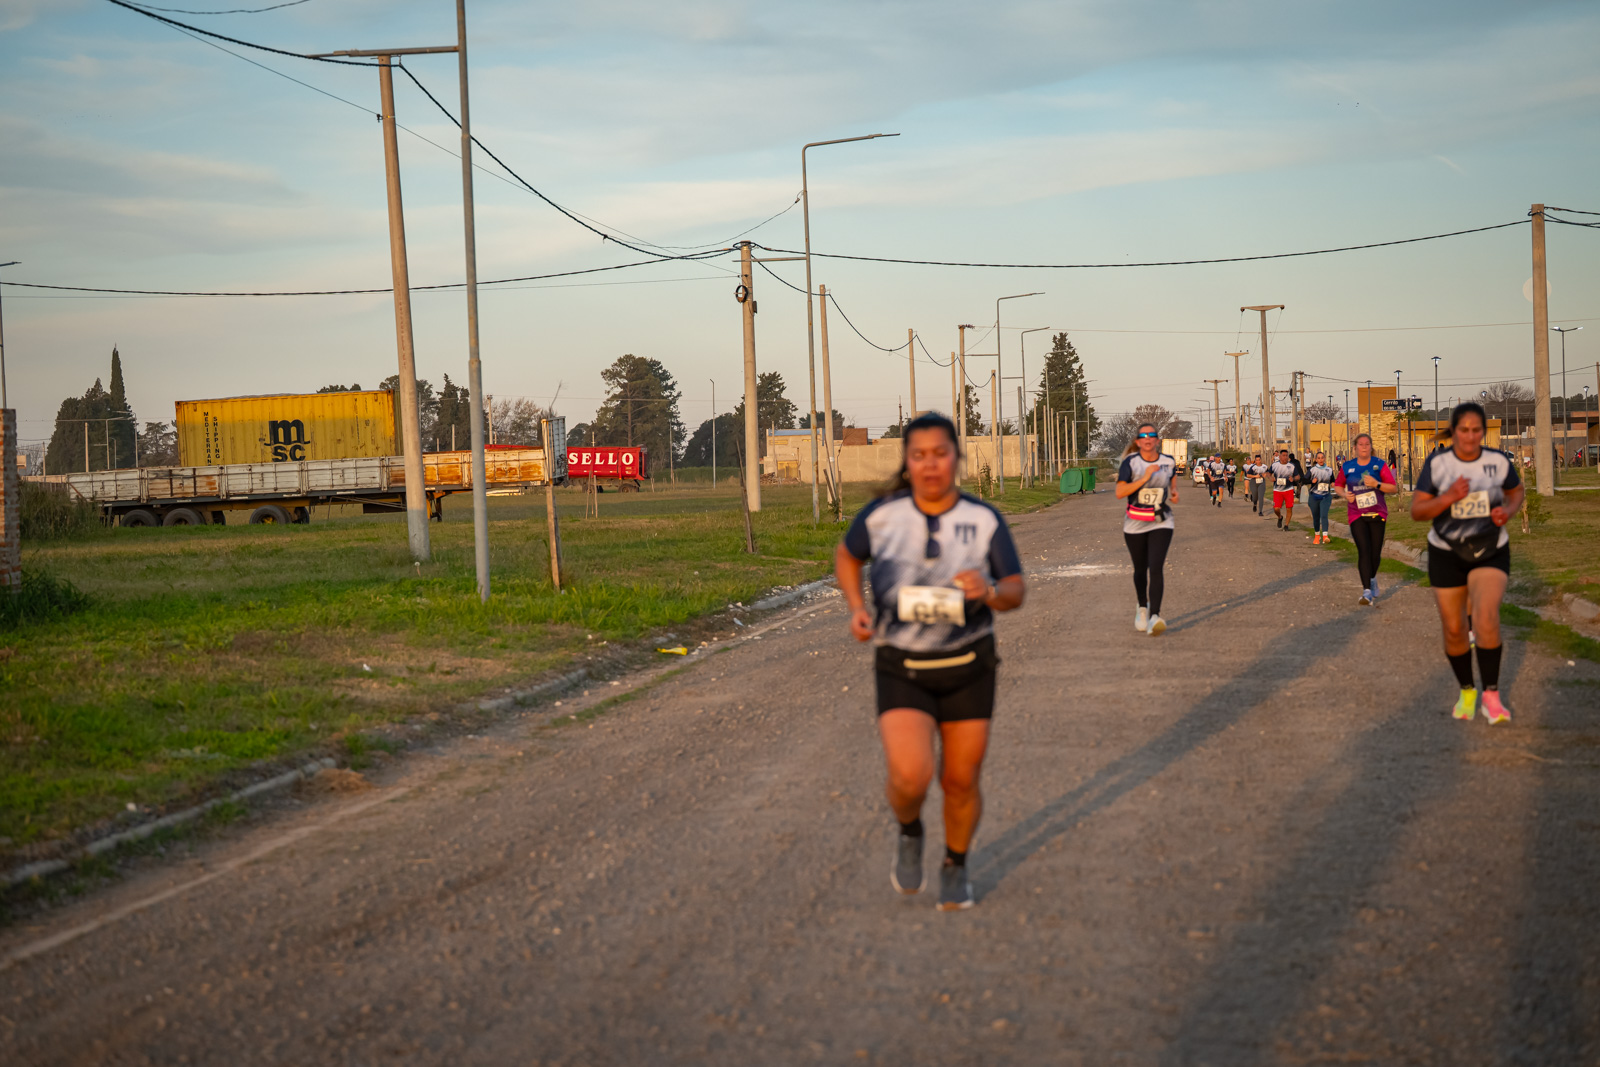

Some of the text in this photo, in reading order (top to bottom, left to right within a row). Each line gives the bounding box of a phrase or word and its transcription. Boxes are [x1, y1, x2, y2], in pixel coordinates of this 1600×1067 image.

[203, 411, 212, 466] MEDITERRAN
[213, 416, 221, 459] SHIPPING
[568, 452, 634, 465] SELLO
[1358, 495, 1377, 508] 543
[1454, 500, 1487, 516] 525
